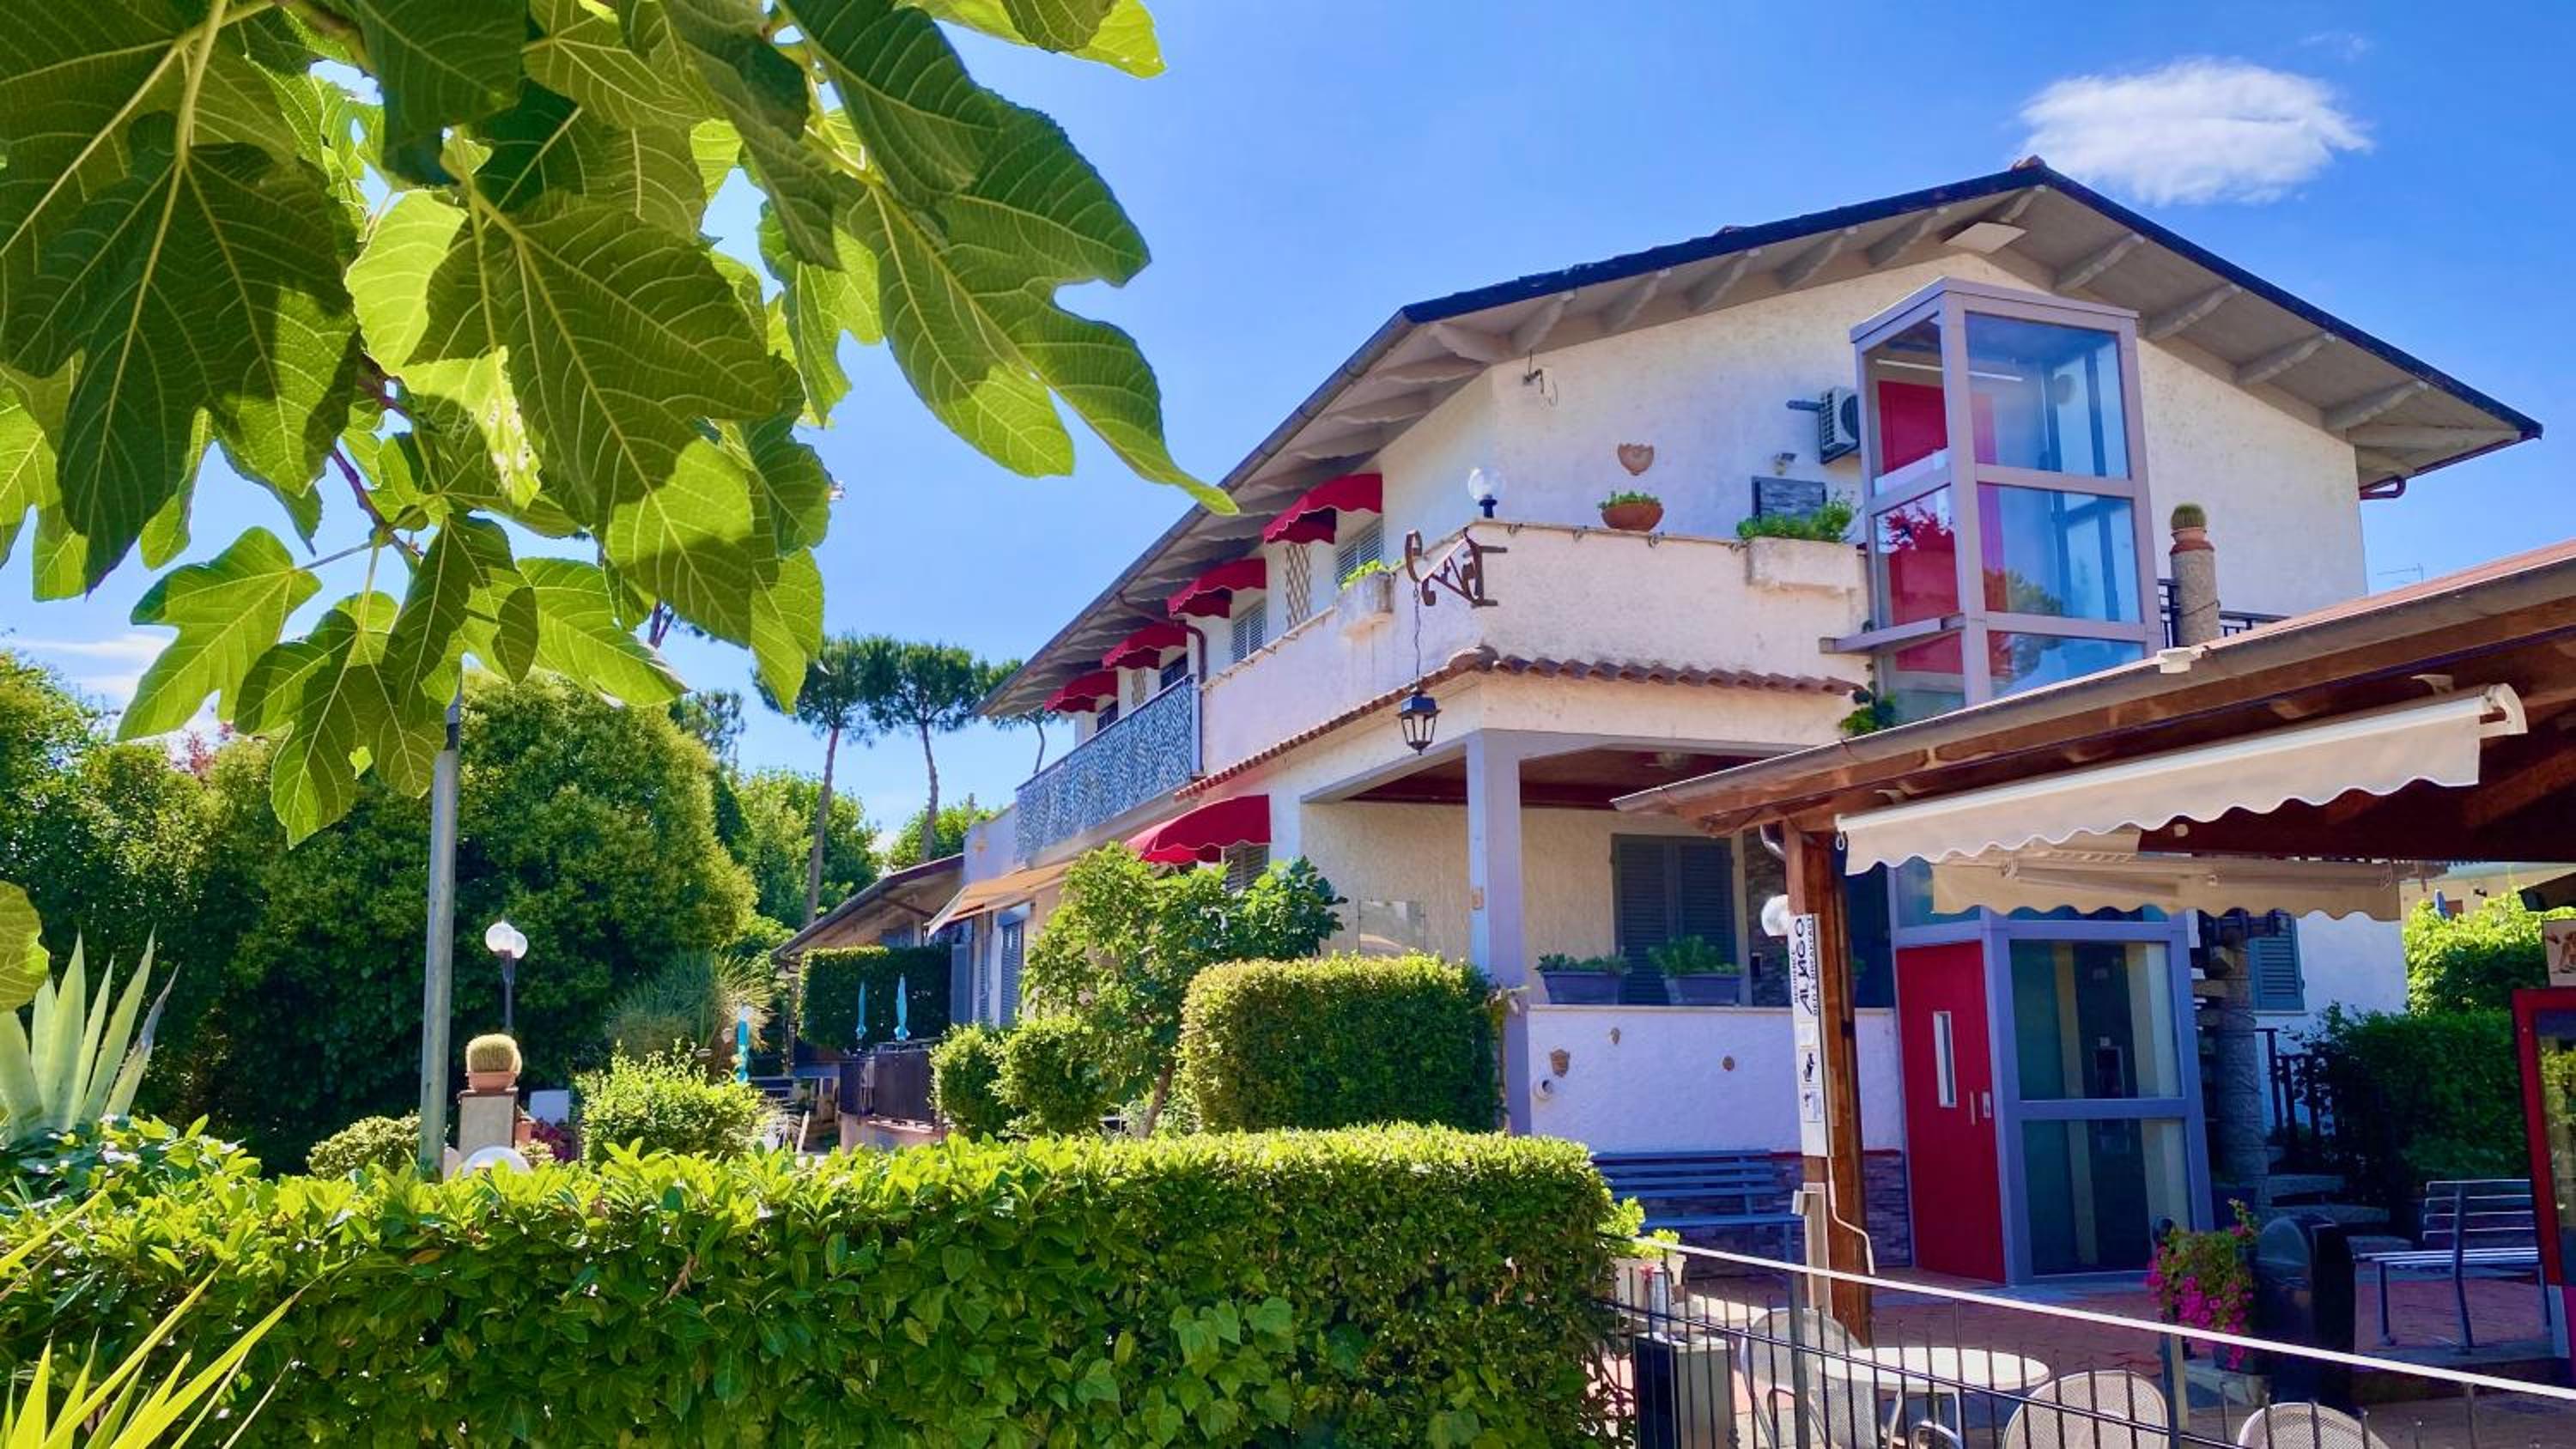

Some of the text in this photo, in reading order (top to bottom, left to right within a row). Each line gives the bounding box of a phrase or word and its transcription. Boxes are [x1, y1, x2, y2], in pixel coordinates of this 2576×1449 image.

[1807, 918, 1816, 979] BREAKFAST
[1790, 949, 1799, 1003] RESIDENCE
[1800, 985, 1812, 1015] AL
